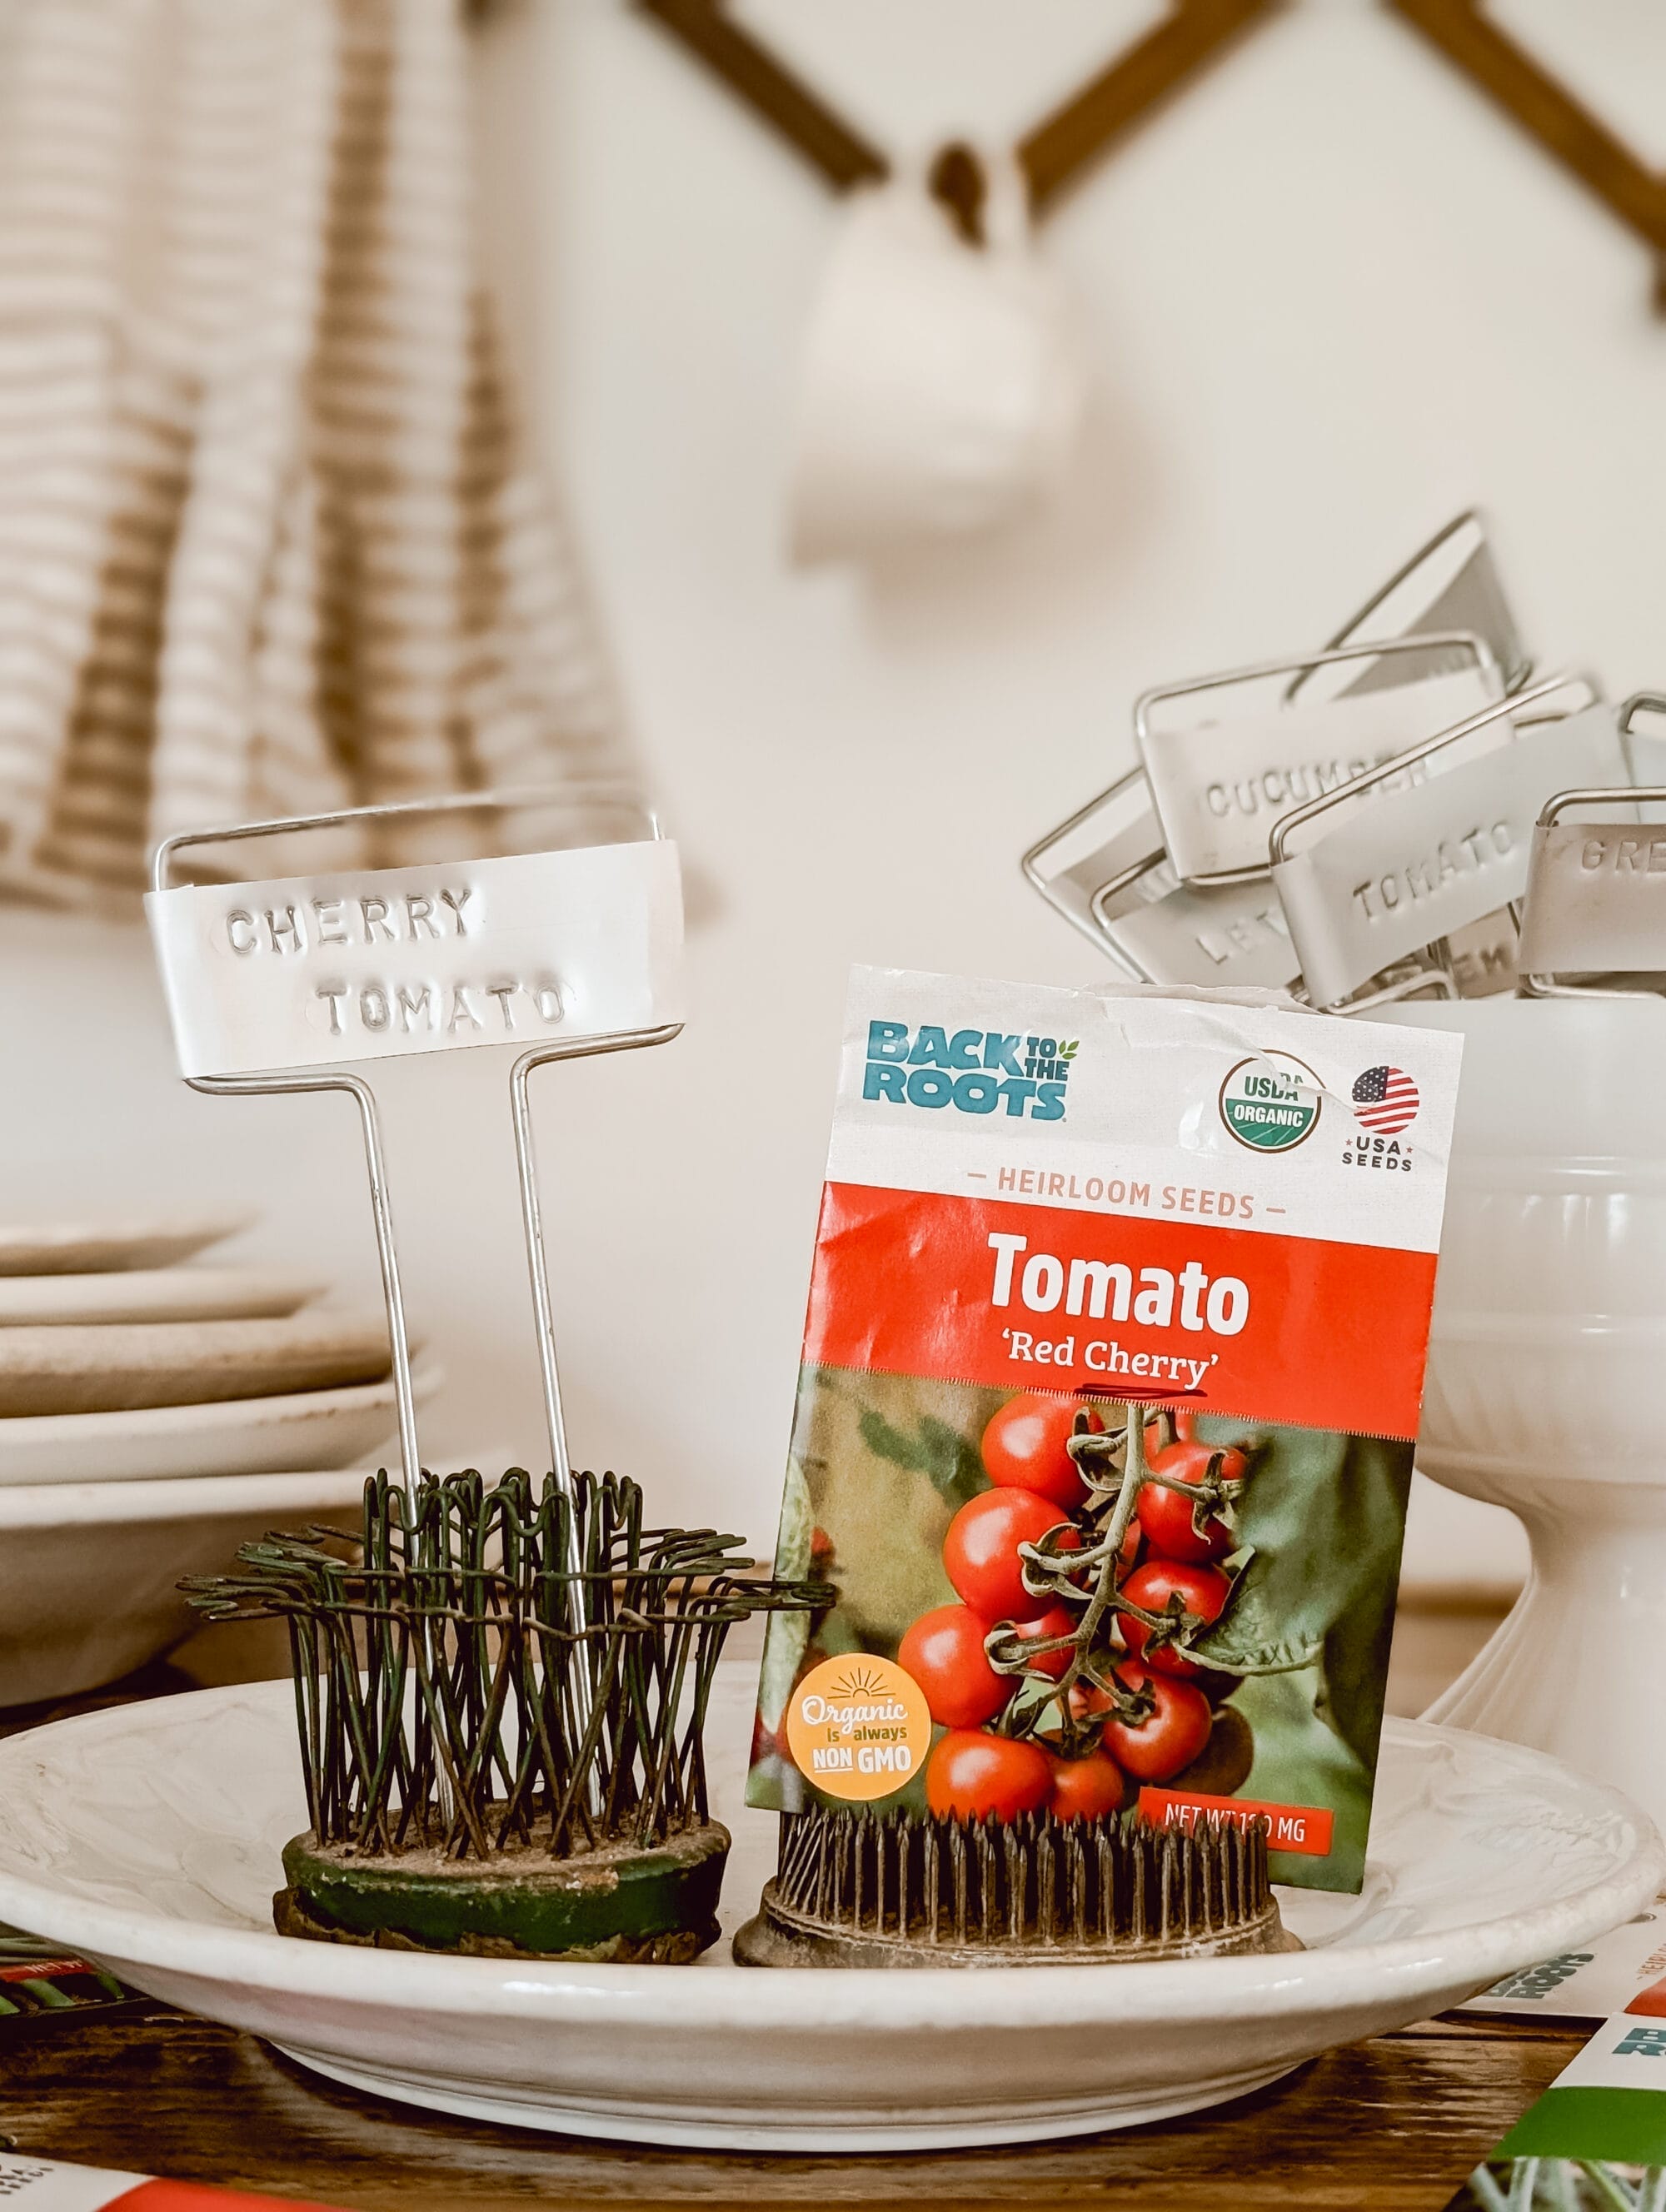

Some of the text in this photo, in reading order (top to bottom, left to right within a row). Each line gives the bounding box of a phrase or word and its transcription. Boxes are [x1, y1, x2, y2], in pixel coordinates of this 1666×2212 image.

[1353, 820, 1514, 919] TOMATO
[226, 888, 472, 955] CHERRY
[315, 980, 566, 1036] TOMATO
[867, 1019, 1025, 1077] BACK
[1026, 1035, 1058, 1059] TO
[1025, 1058, 1070, 1082] THE
[1244, 1072, 1304, 1102] USDA
[863, 1062, 1067, 1121] ROOTS
[1234, 1104, 1304, 1128] ORGANIC
[1341, 1152, 1413, 1172] SEEDS
[1355, 1135, 1402, 1156] USA
[998, 1167, 1255, 1220] HEIRLOOM SEEDS
[987, 1232, 1250, 1336] Tomato
[801, 1694, 909, 1736] Organic
[853, 1725, 907, 1742] always
[812, 1744, 912, 1774] NON GMO
[1165, 1802, 1202, 1833] NET
[1206, 1807, 1237, 1834] W
[1277, 1816, 1306, 1843] MG
